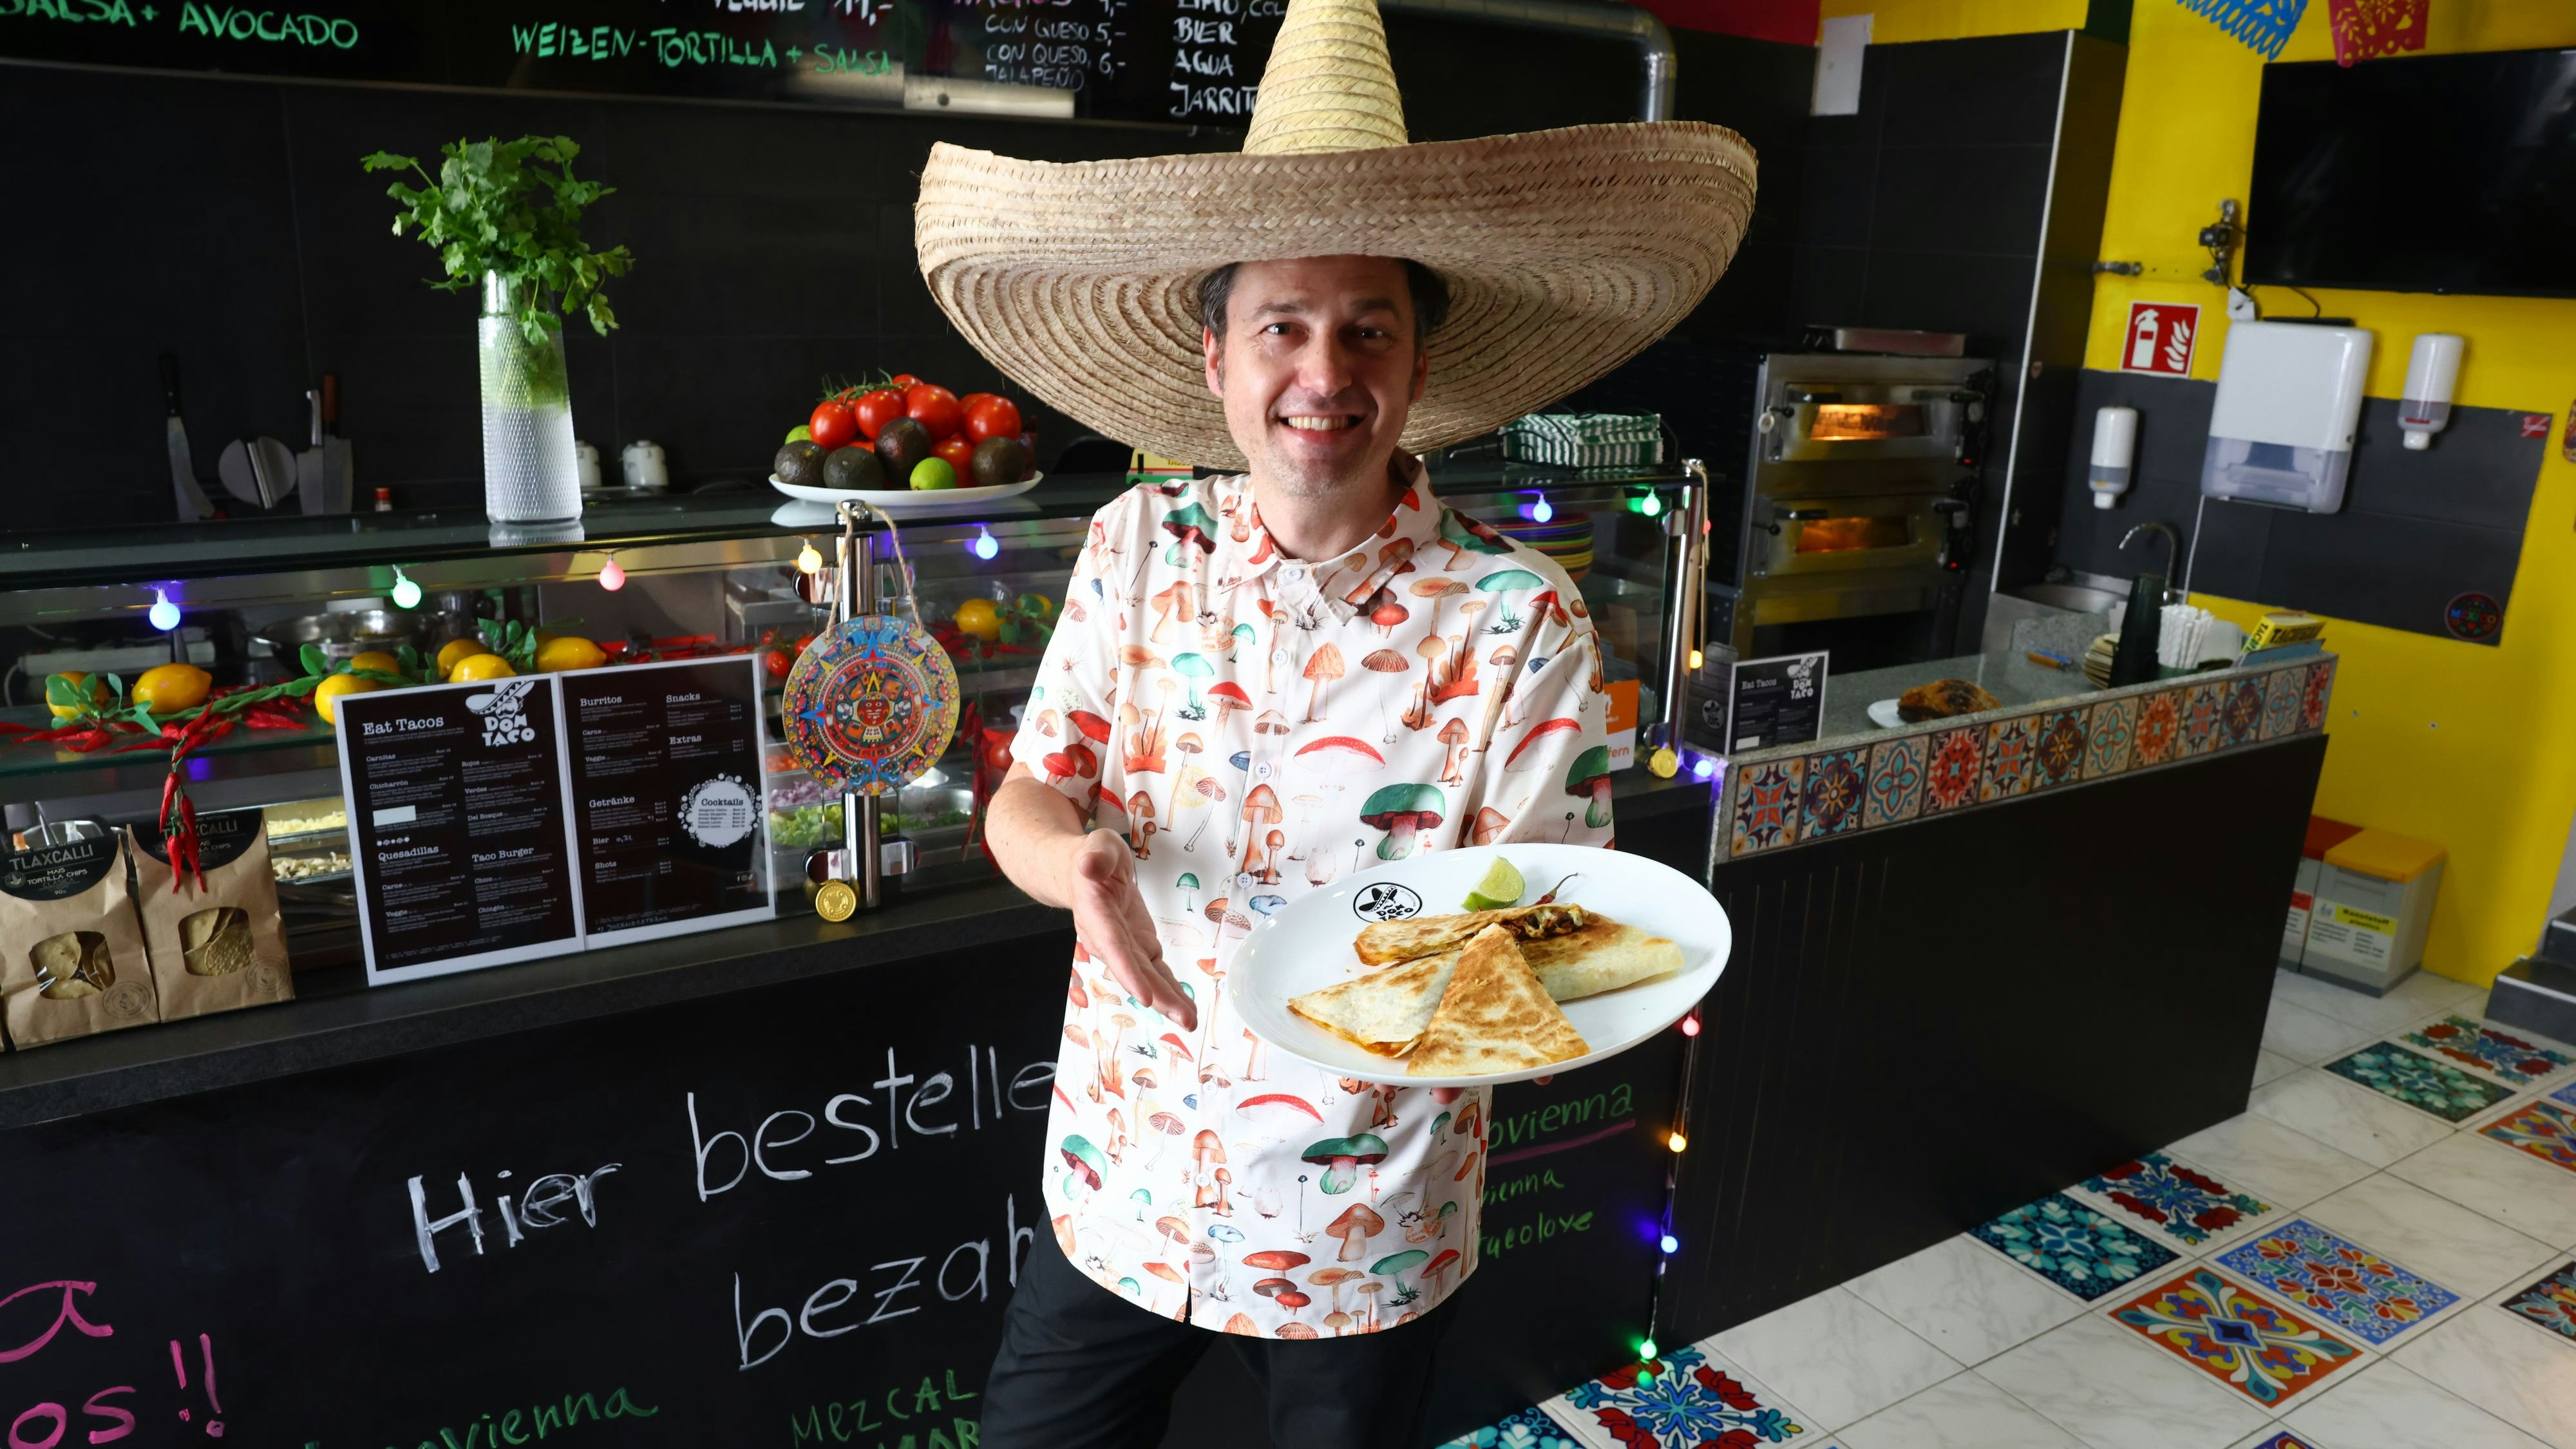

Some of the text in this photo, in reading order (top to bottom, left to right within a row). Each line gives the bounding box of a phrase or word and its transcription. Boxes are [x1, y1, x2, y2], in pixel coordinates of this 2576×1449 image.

[180, 1, 357, 48] AVOCADO
[985, 14, 1028, 32] CON
[1035, 18, 1089, 40] QUESO
[1173, 17, 1237, 45] BIER
[815, 43, 891, 75] SALSA
[987, 43, 1025, 62] CON
[1171, 48, 1233, 77] AGUA
[580, 696, 622, 707] Burritos
[666, 693, 701, 703] Snacks
[1791, 688, 1814, 699] TACO
[363, 717, 444, 735] Eat Tacos
[484, 714, 527, 732] DON
[482, 727, 535, 747] TACO
[669, 735, 702, 744] Extras
[366, 753, 396, 762] Carnitas
[465, 786, 488, 794] Verdes
[589, 796, 635, 808] Getränke
[480, 811, 503, 821] Bosque
[162, 820, 238, 840] TCALLI
[9, 844, 93, 870] TLAXCALLI
[378, 845, 439, 861] Quesadillas
[472, 848, 535, 862] Taco Burger
[595, 860, 617, 869] Shots
[27, 869, 88, 885] TORTILLA CHIPS
[475, 876, 493, 884] Chico
[386, 909, 408, 918] Veggie
[408, 1044, 1057, 1274] Hier bestelle
